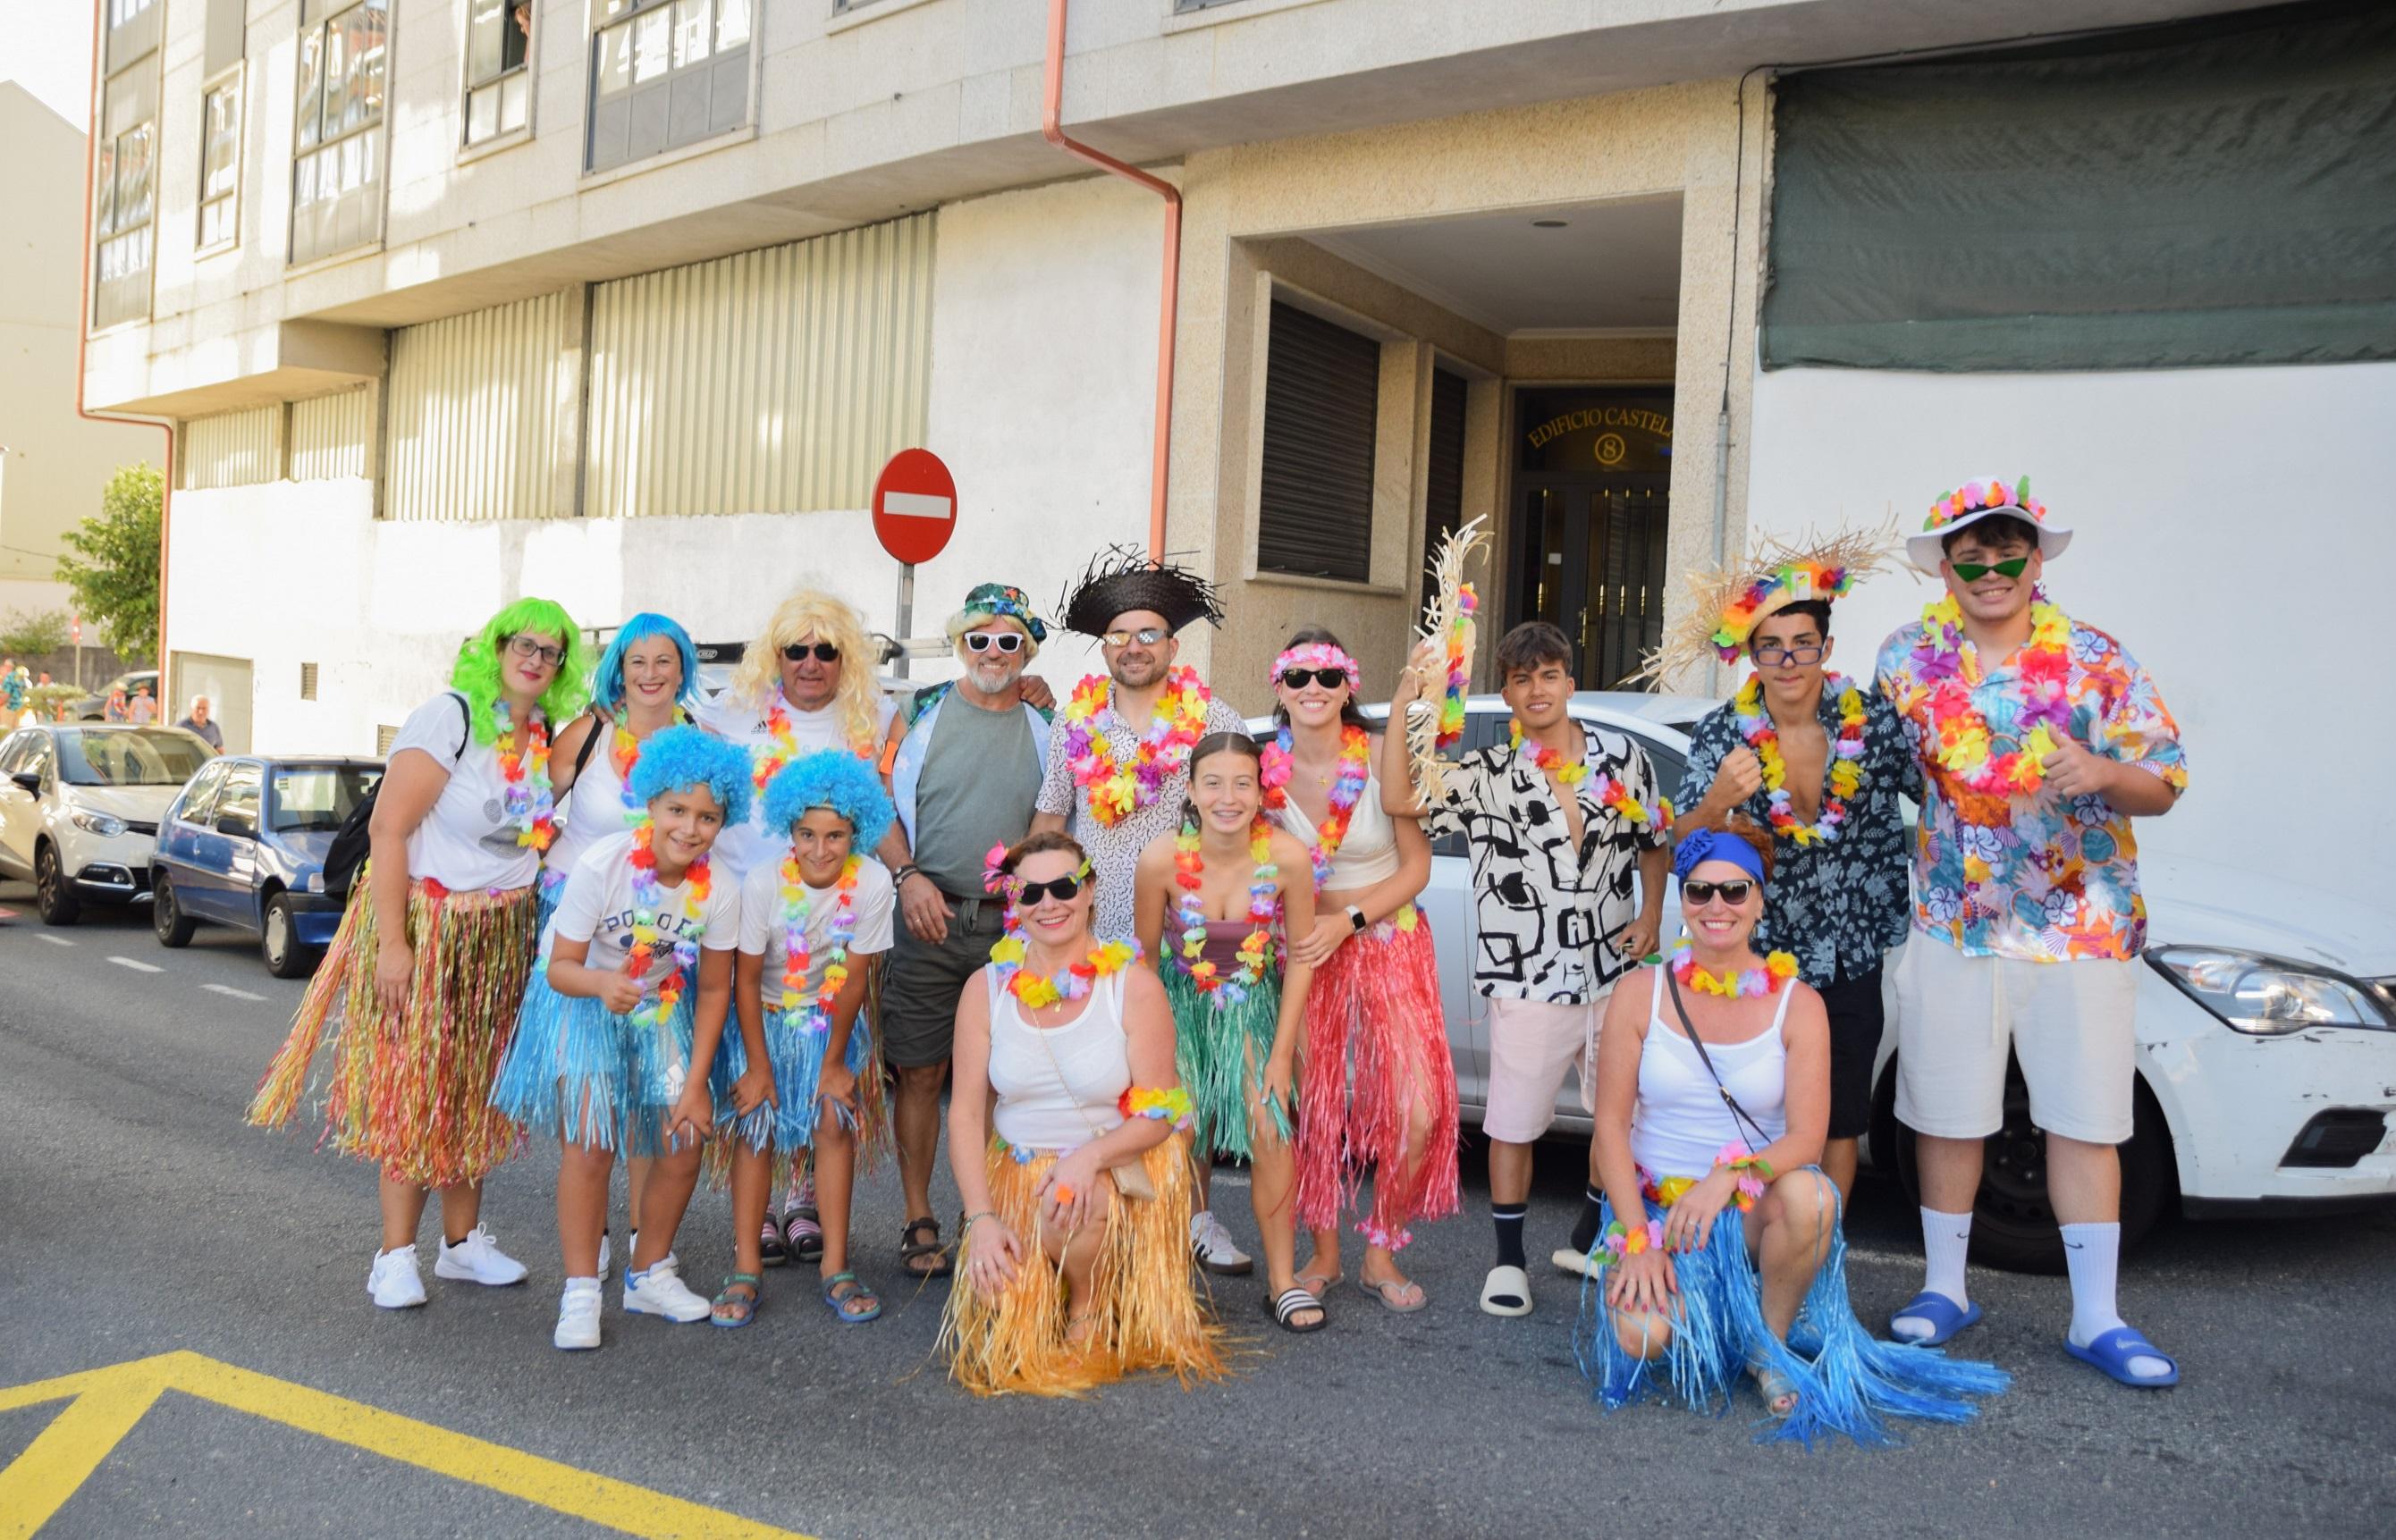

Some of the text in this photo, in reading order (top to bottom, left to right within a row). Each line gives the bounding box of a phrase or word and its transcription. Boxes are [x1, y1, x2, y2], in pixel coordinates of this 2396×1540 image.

[1528, 407, 1673, 448] EDIFICIO CASTEL
[1603, 440, 1616, 459] 8
